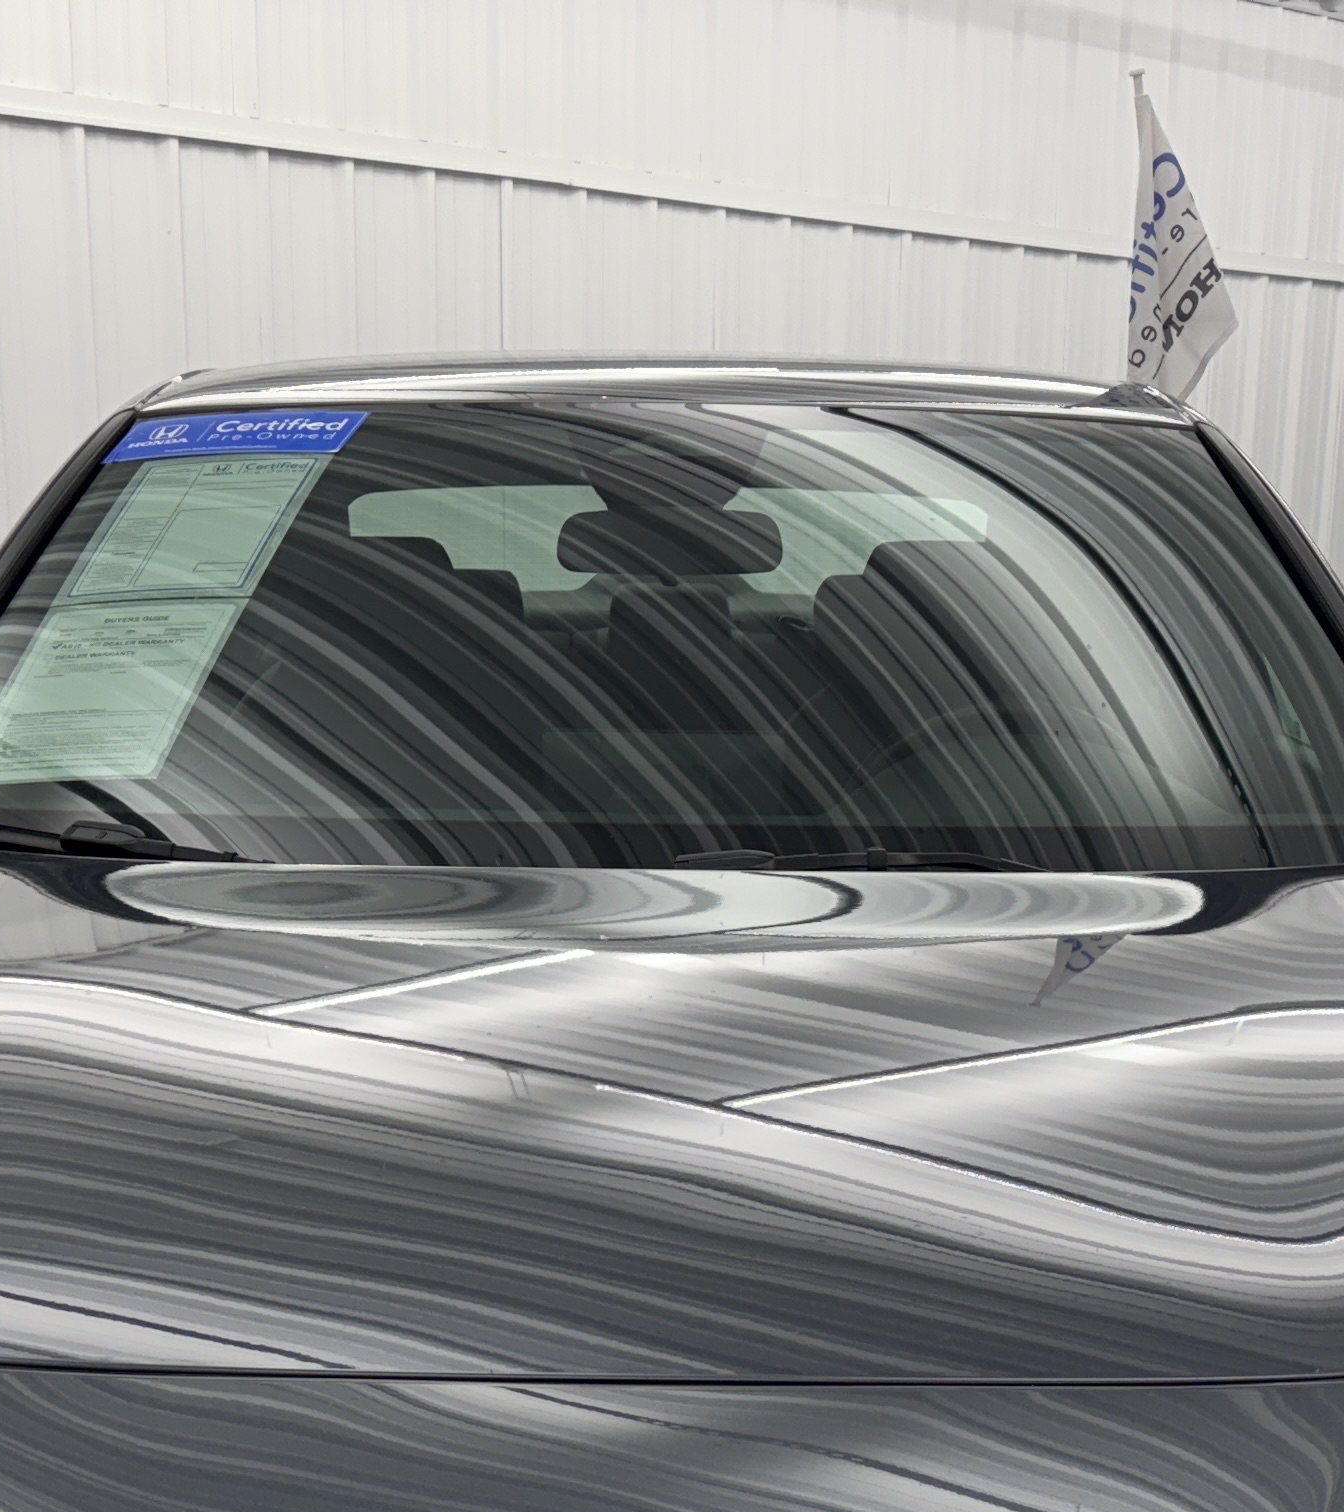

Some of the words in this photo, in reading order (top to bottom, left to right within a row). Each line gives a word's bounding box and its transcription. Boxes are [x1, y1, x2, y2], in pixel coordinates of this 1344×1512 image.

[216, 417, 349, 433] Certified
[206, 431, 337, 441] Pre-Owned
[127, 437, 189, 448] HONDA
[245, 461, 309, 471] Certified
